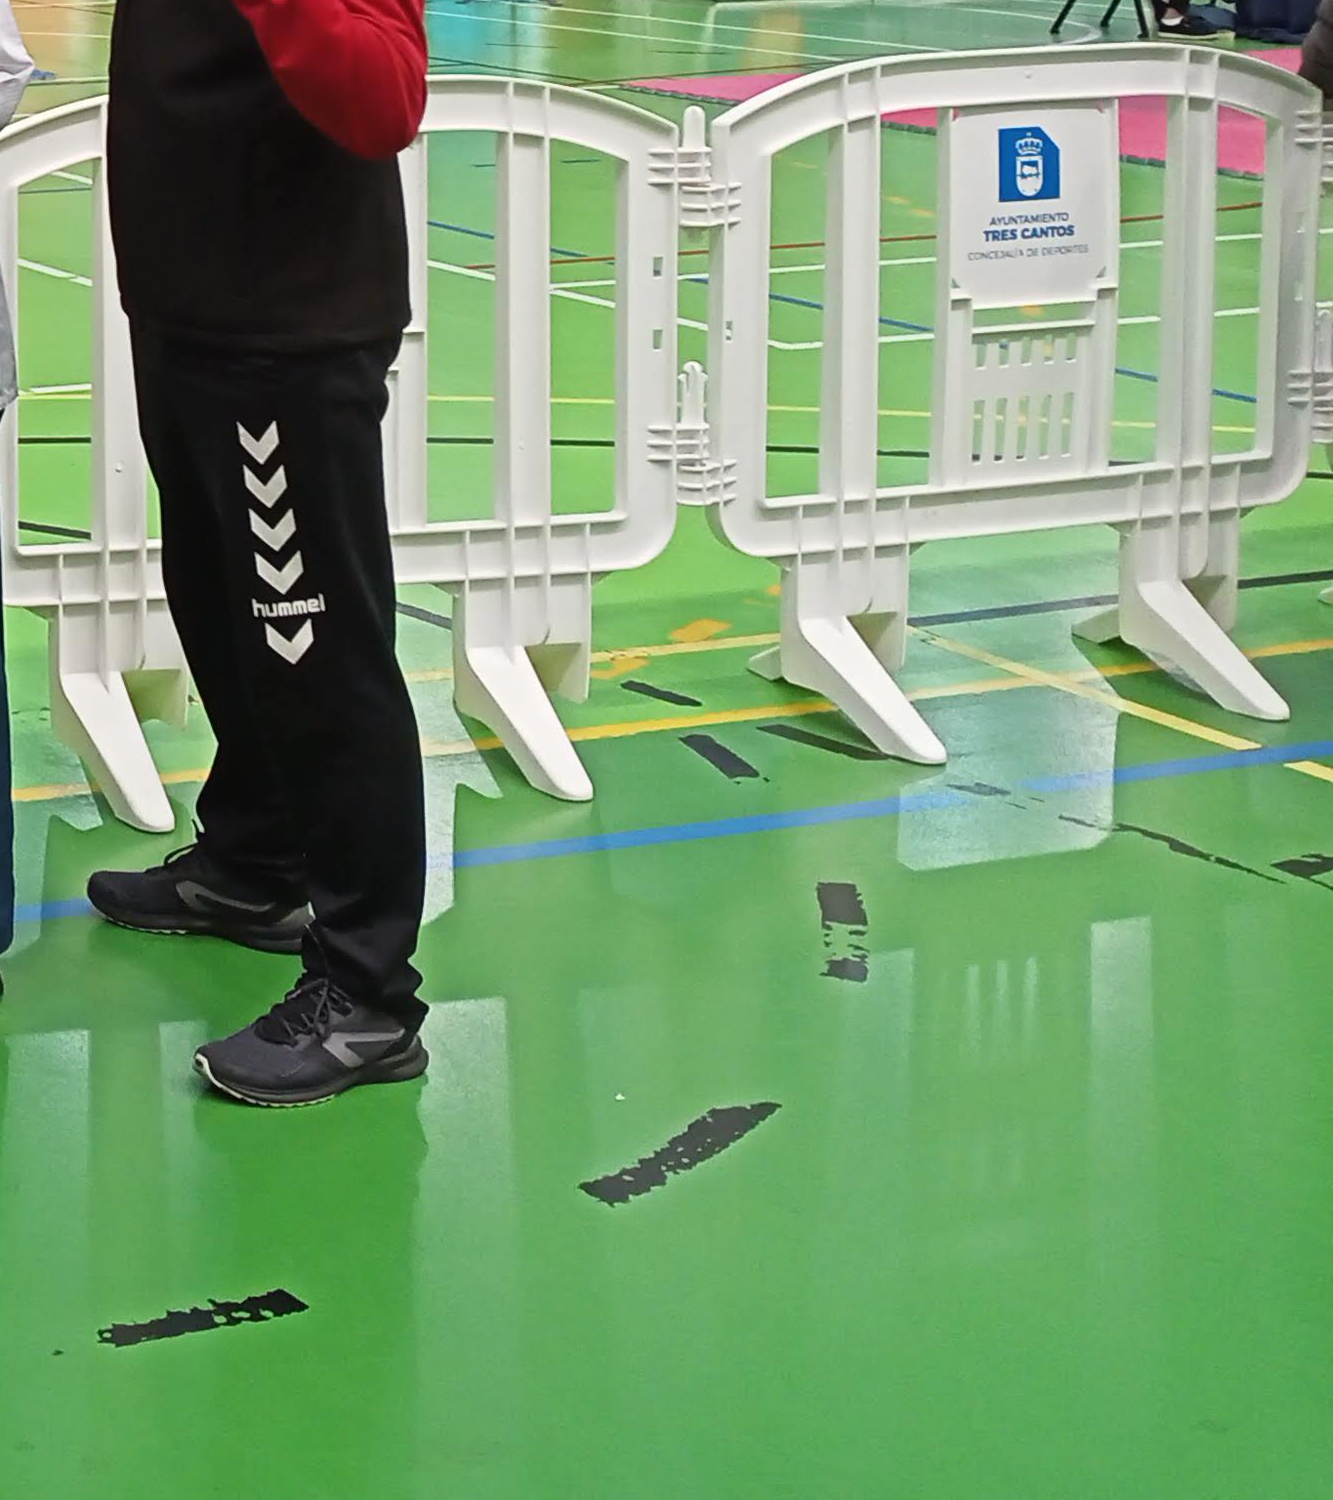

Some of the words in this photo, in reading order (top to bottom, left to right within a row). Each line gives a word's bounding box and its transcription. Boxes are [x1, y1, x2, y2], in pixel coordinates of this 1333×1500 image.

[989, 212, 1070, 226] AYUNTAMIENTO
[983, 228, 1018, 242] TRES
[1021, 225, 1075, 240] CANTOS
[1027, 247, 1039, 258] DE
[1041, 243, 1090, 257] DEPORTES
[251, 593, 326, 618] hummel
